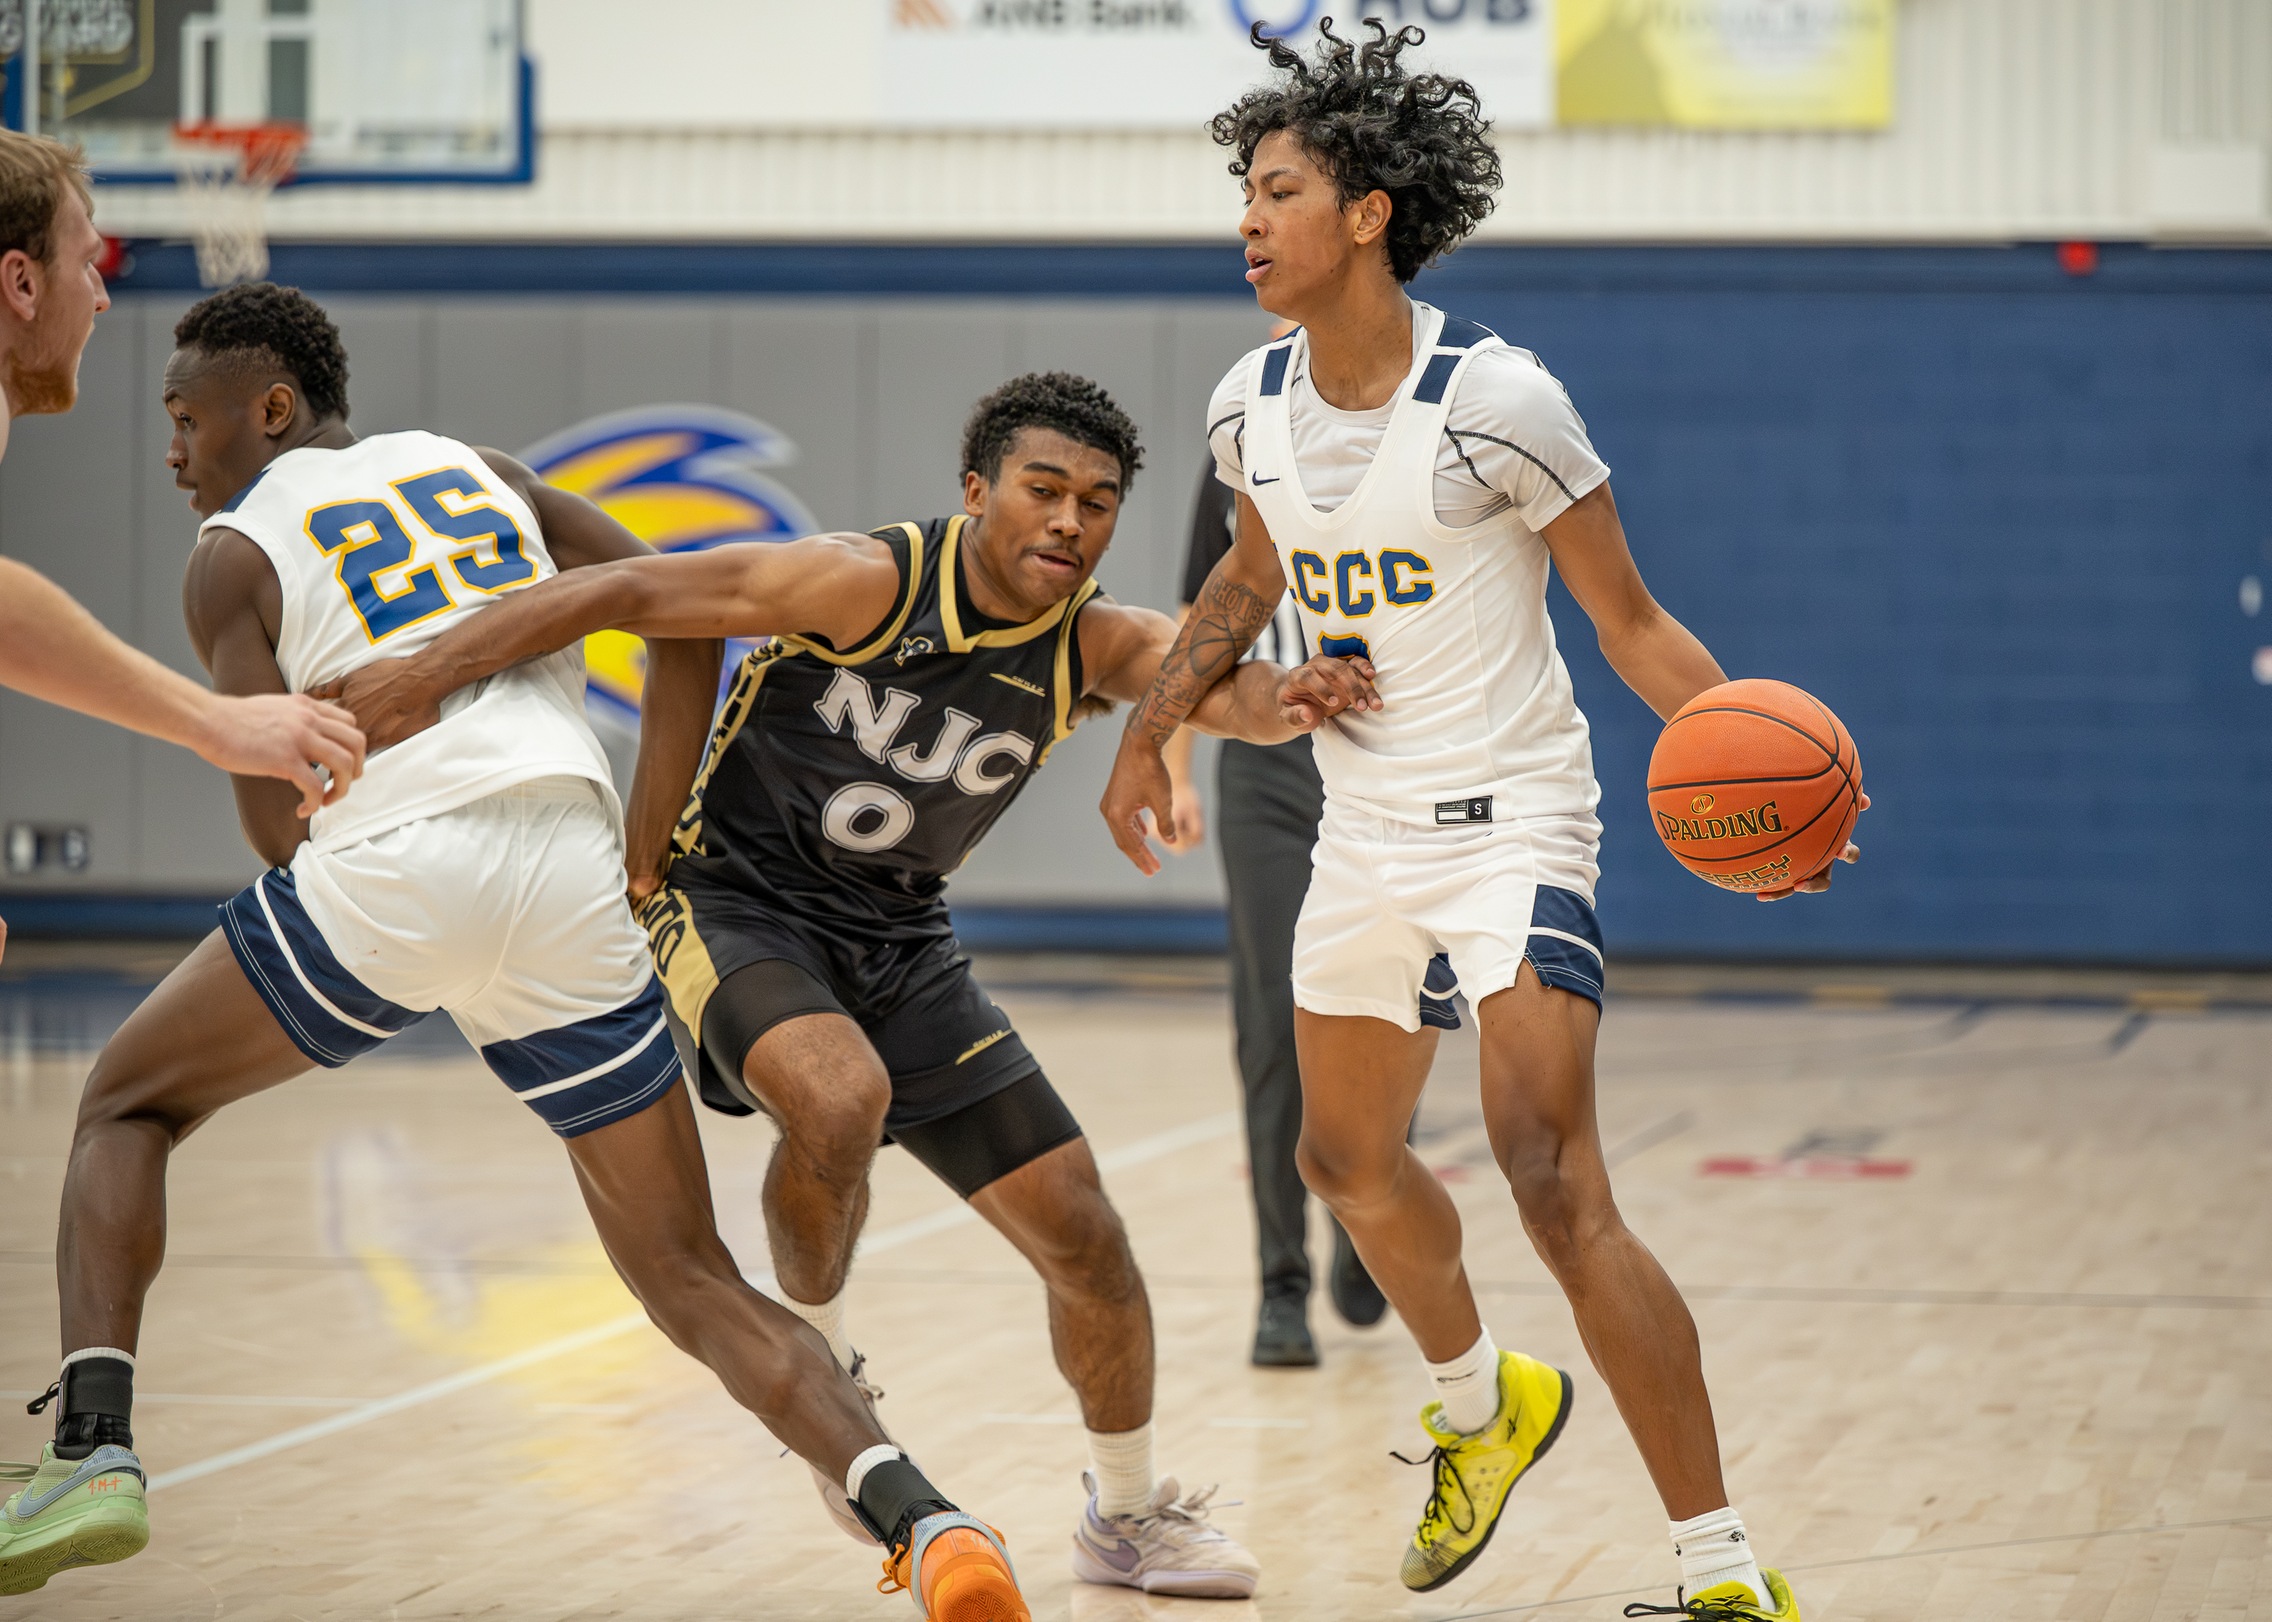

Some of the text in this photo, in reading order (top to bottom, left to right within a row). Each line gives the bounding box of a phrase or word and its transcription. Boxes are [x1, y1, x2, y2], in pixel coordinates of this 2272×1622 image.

[303, 465, 539, 646] 25
[1272, 539, 1437, 619] CCC
[813, 666, 1036, 796] NJC
[821, 781, 916, 854] 0
[1474, 802, 1483, 816] S
[1656, 800, 1783, 841] SPALDING
